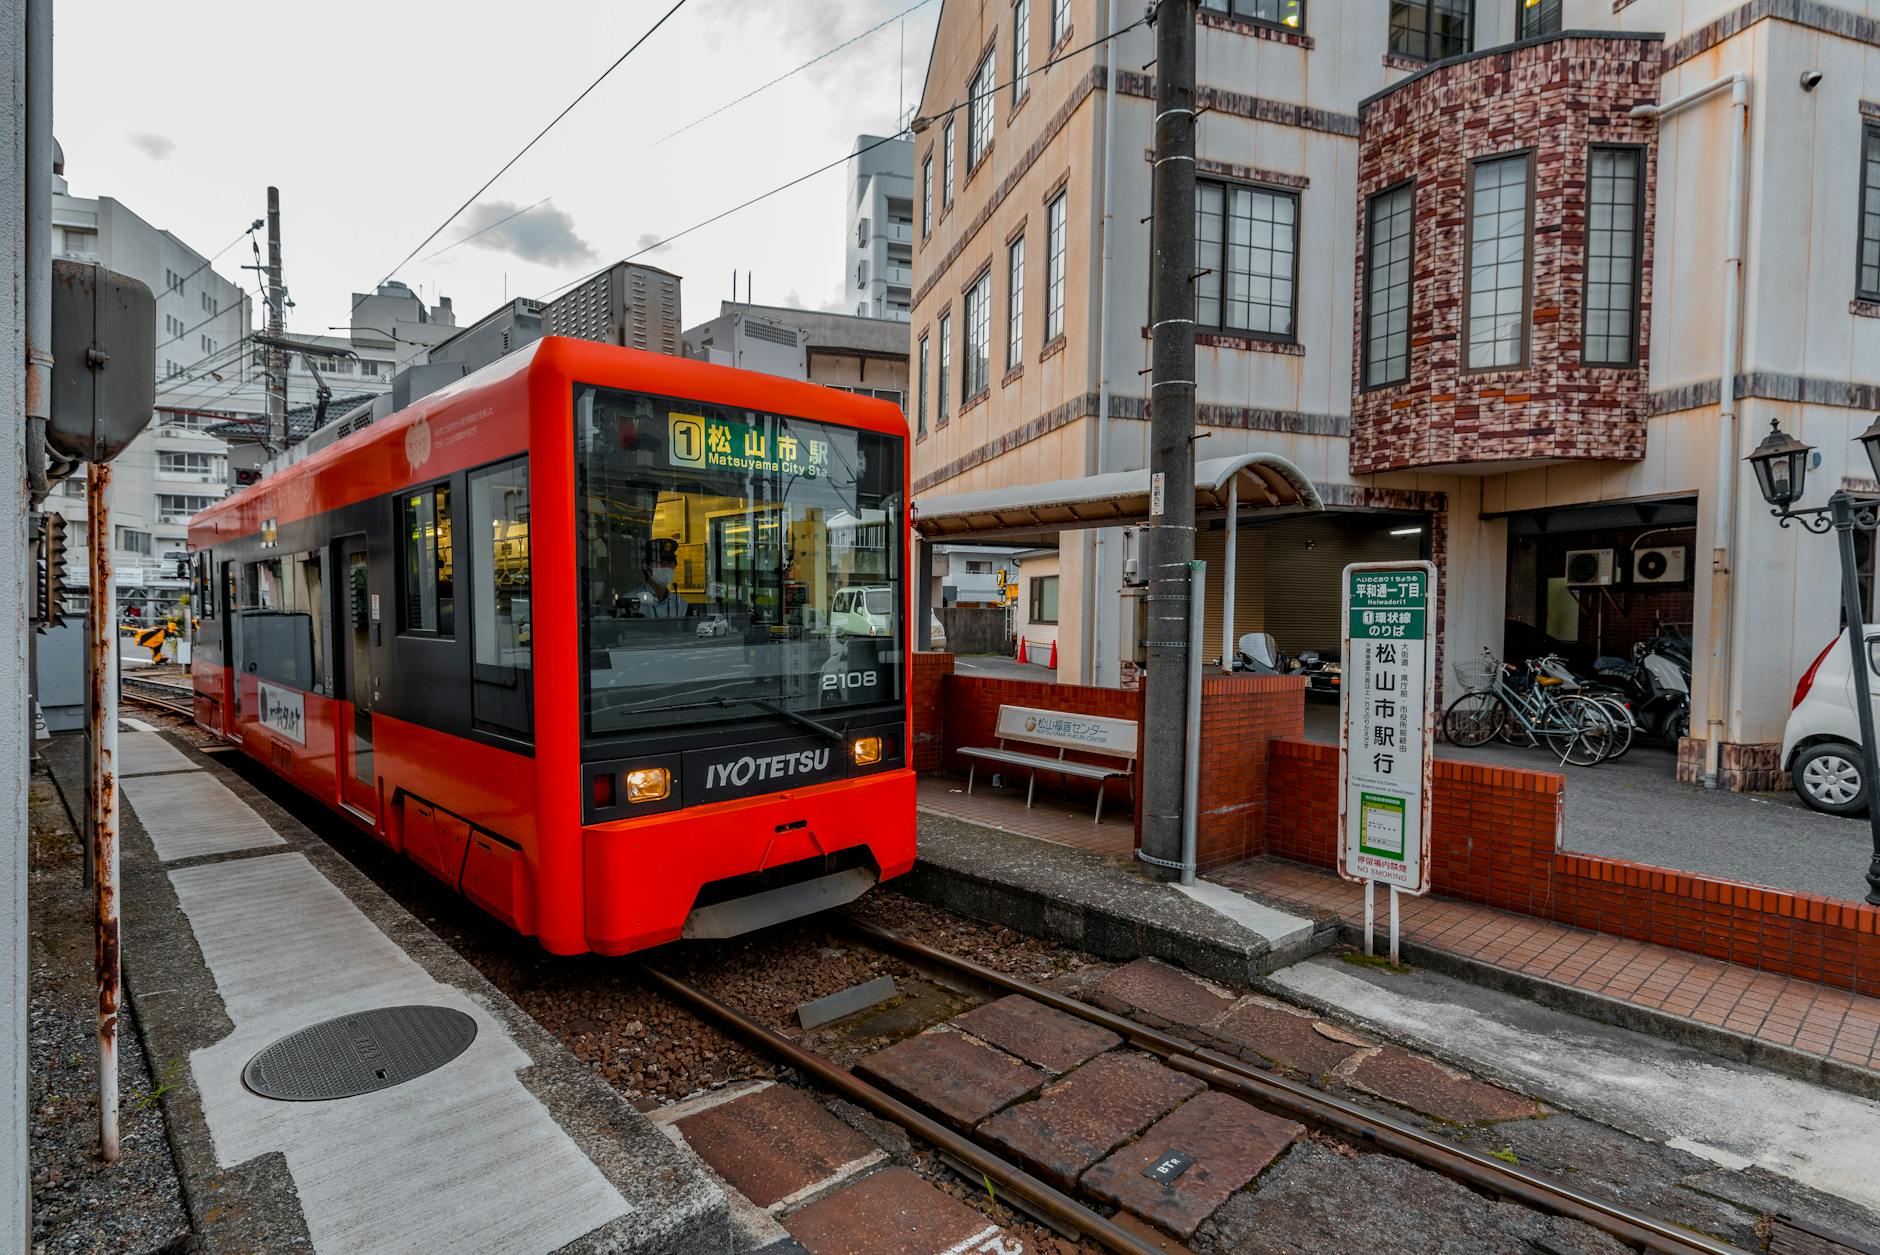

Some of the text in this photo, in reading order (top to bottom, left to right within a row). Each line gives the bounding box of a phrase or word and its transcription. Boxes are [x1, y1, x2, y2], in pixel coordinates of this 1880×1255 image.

[678, 424, 829, 466] 1 松山市駅
[708, 452, 779, 472] Matsuyama
[781, 461, 805, 476] City
[1356, 583, 1419, 598] 平和通一丁目
[1369, 626, 1405, 637] のりば
[822, 670, 877, 690] 2108
[1373, 643, 1396, 774] 松山市駅行
[1037, 717, 1108, 736] 松山福音センター
[705, 747, 830, 789] IYOTETSU
[1357, 865, 1407, 882] NO SMOKING
